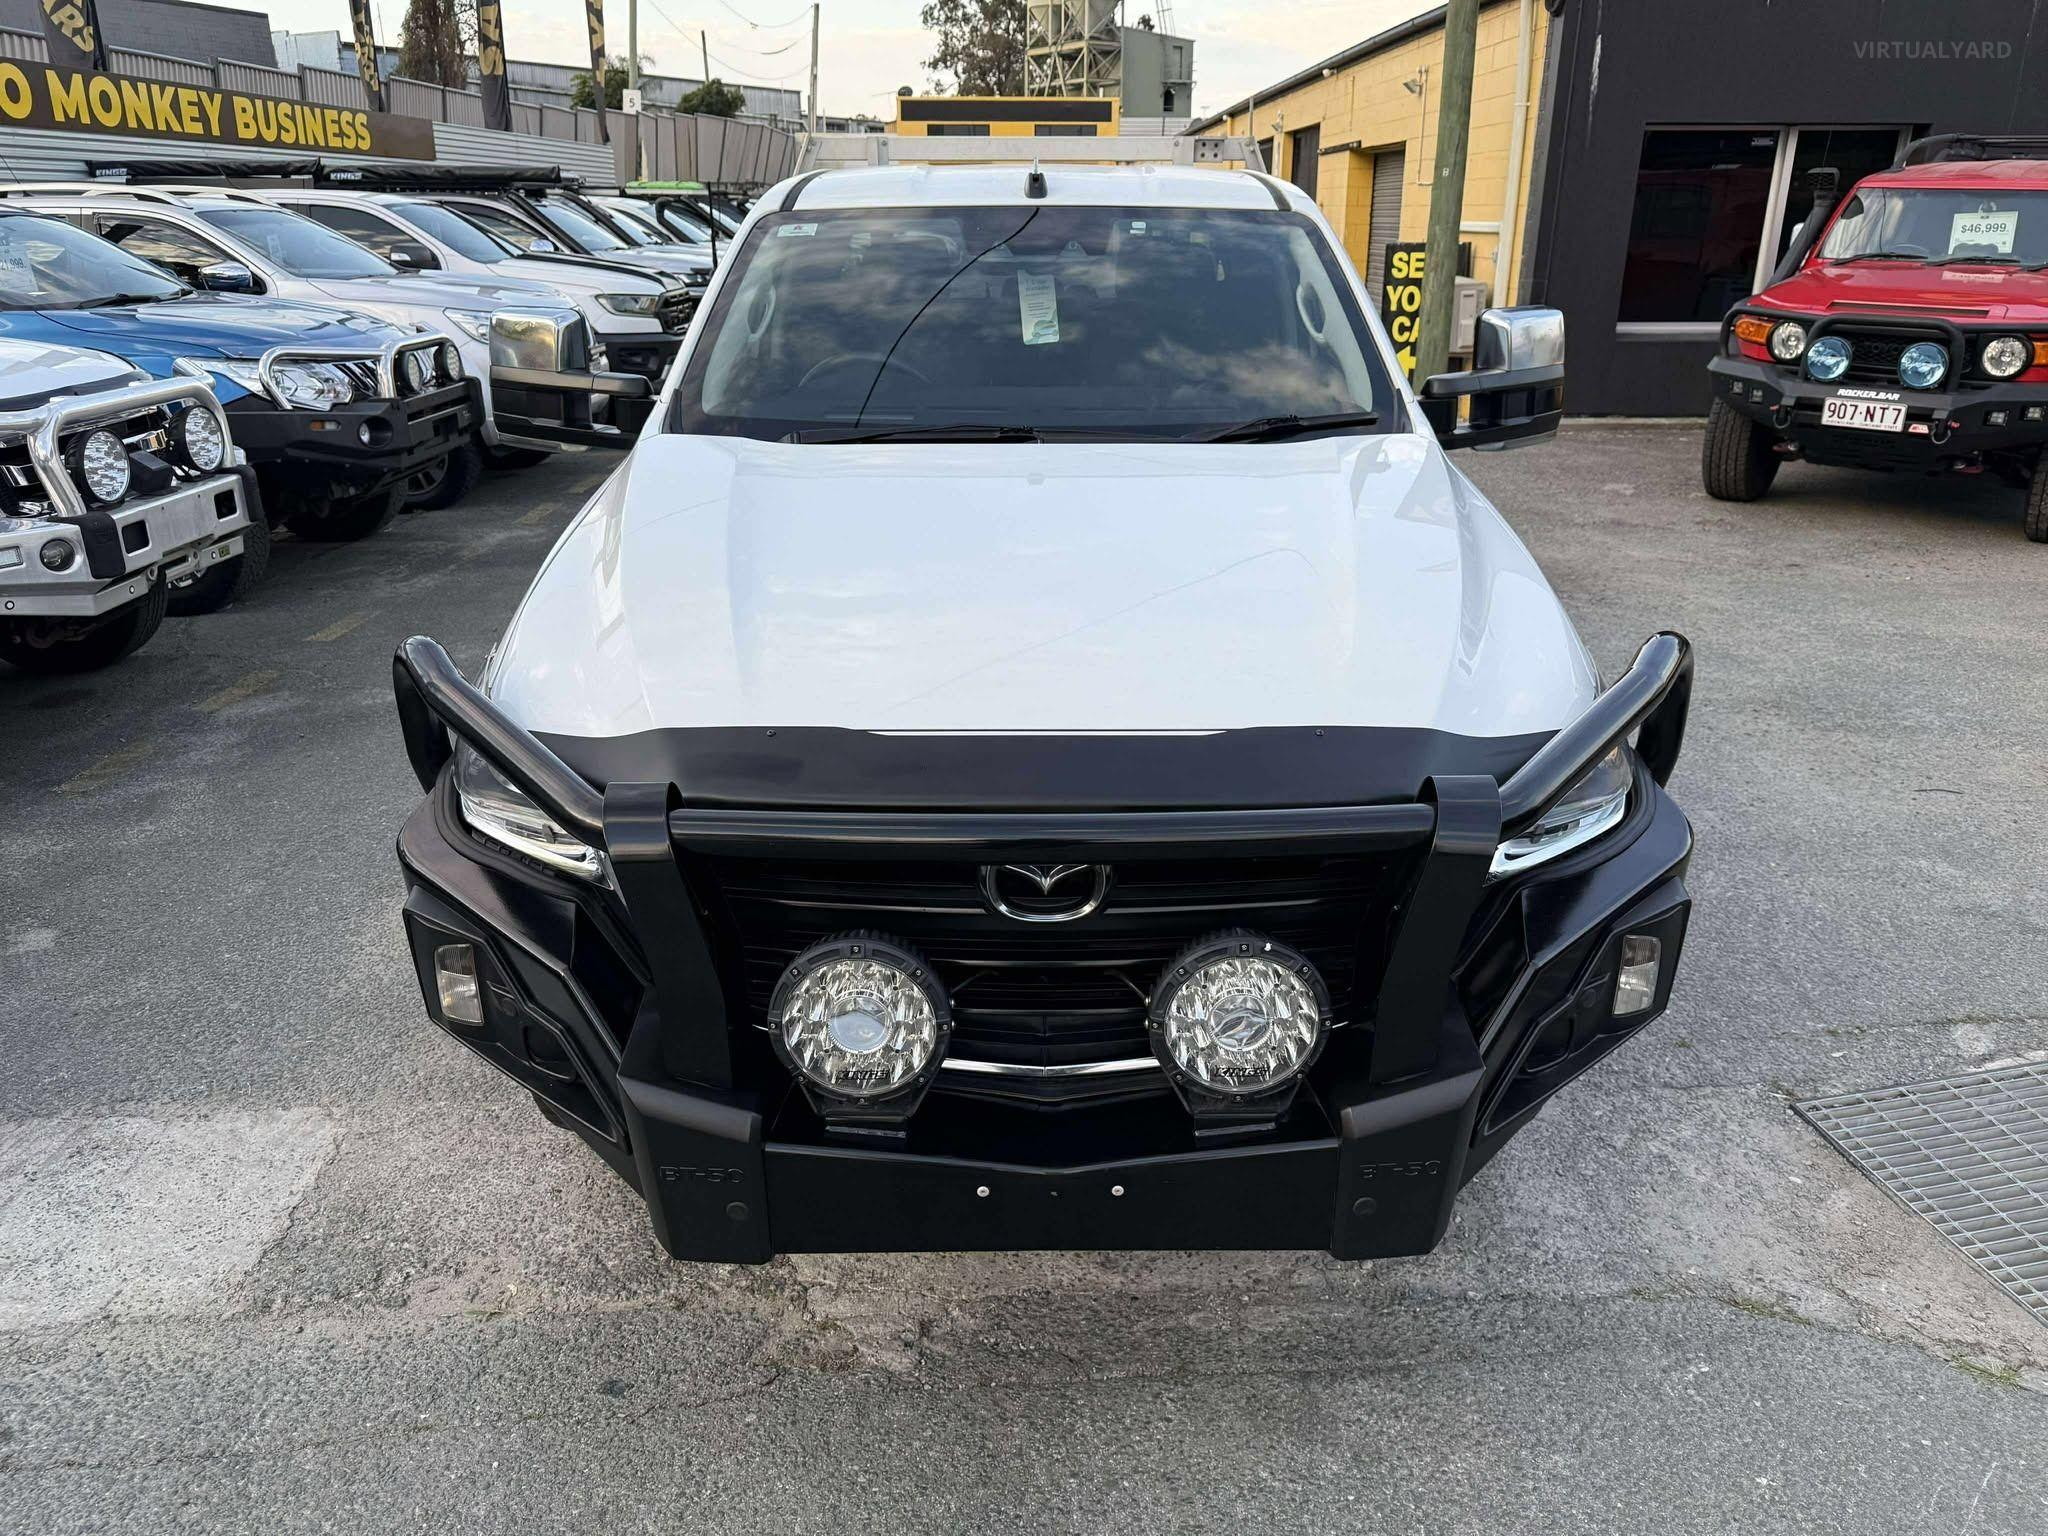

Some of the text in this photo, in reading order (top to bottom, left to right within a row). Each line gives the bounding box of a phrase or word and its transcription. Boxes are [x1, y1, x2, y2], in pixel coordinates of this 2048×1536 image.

[45, 69, 222, 137] MONKEY
[232, 95, 372, 151] BUSINESS
[330, 172, 362, 180] KINGS
[1391, 251, 1426, 279] SE
[1386, 285, 1422, 313] YO
